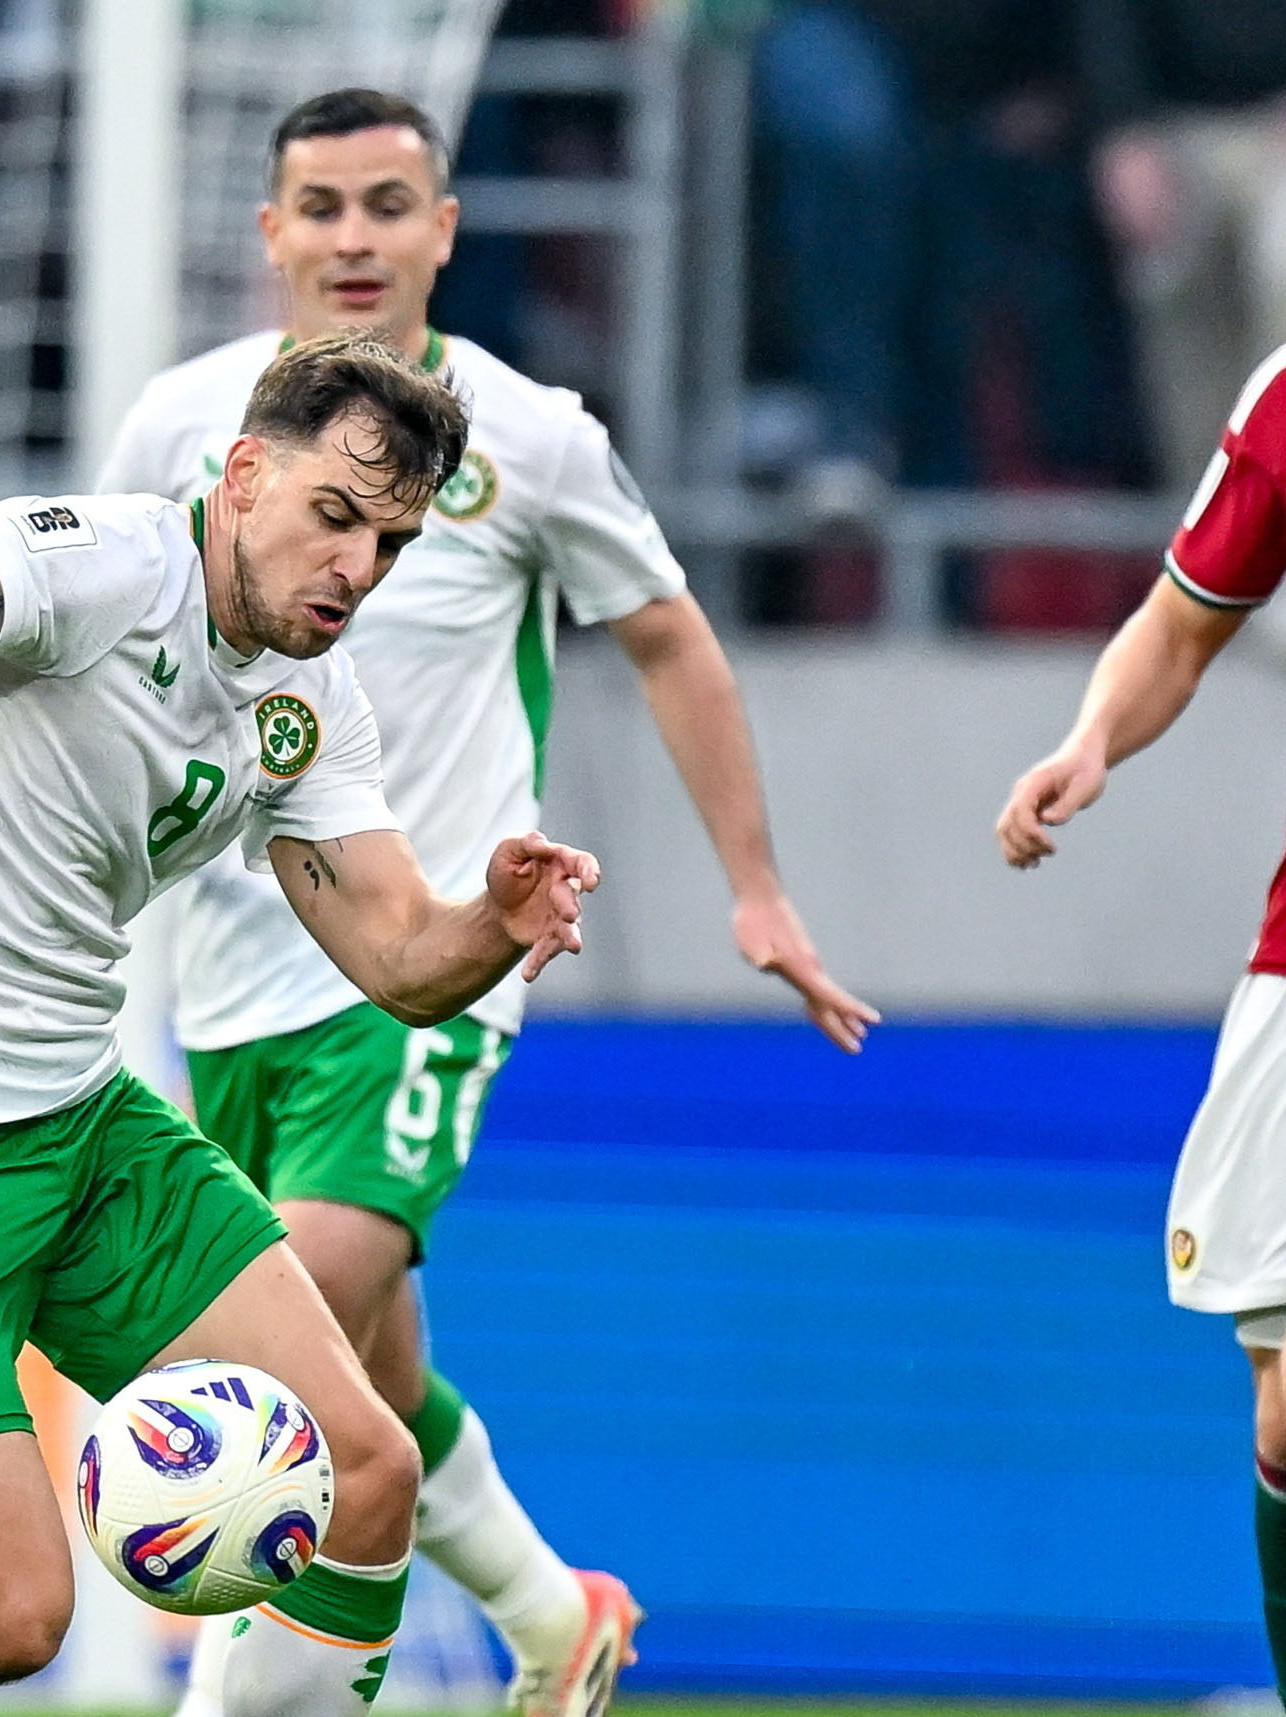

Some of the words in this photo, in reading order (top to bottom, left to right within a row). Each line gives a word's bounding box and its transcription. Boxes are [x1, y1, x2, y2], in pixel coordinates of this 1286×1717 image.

[258, 699, 315, 730] IRELAND
[147, 759, 225, 858] 8
[383, 1026, 454, 1140] 6
